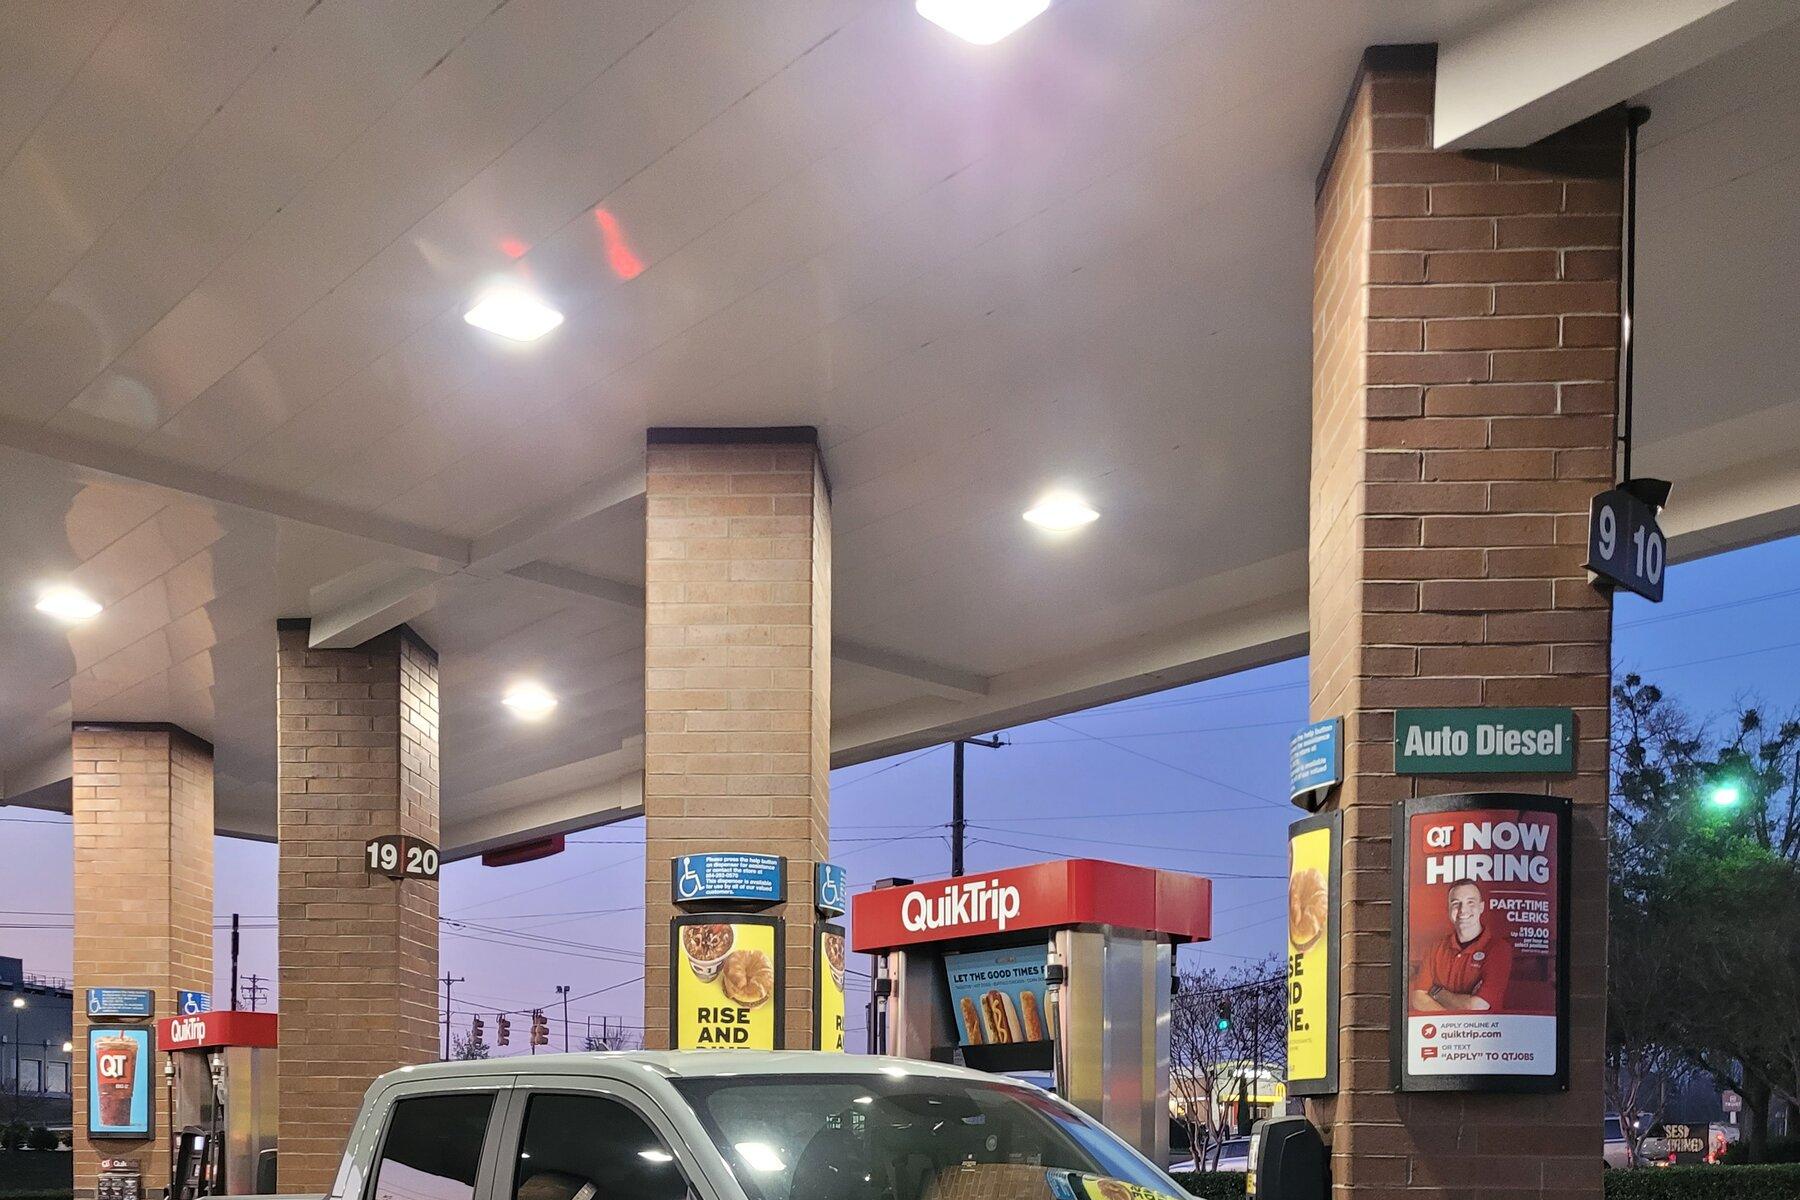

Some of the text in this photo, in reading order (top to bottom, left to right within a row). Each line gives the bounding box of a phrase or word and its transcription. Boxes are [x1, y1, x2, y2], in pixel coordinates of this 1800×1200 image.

[1598, 504, 1617, 561] 9
[1633, 524, 1663, 586] 10
[1403, 723, 1563, 757] Auto Diesel
[1426, 821, 1550, 852] QT NOW
[366, 841, 398, 871] 19
[406, 846, 439, 876] 20
[749, 857, 760, 866] help
[761, 859, 777, 867] button
[1426, 853, 1550, 885] HIRING
[901, 878, 1020, 932] QuikTrip
[1489, 898, 1549, 912] PART-TIME
[1506, 911, 1549, 924] CLERKS
[953, 973, 968, 983] LET
[969, 971, 986, 982] THE
[987, 969, 1011, 979] GOOD
[1012, 966, 1039, 977] TIMES
[697, 1007, 750, 1024] RISE
[1490, 1021, 1499, 1029] AT
[171, 1016, 206, 1046] QuikTrip
[698, 1027, 749, 1044] AND
[1440, 1030, 1502, 1040] quiktrip.com
[100, 1054, 127, 1077] QT
[1486, 1052, 1499, 1061] TO
[1501, 1052, 1534, 1061] QTJOBS
